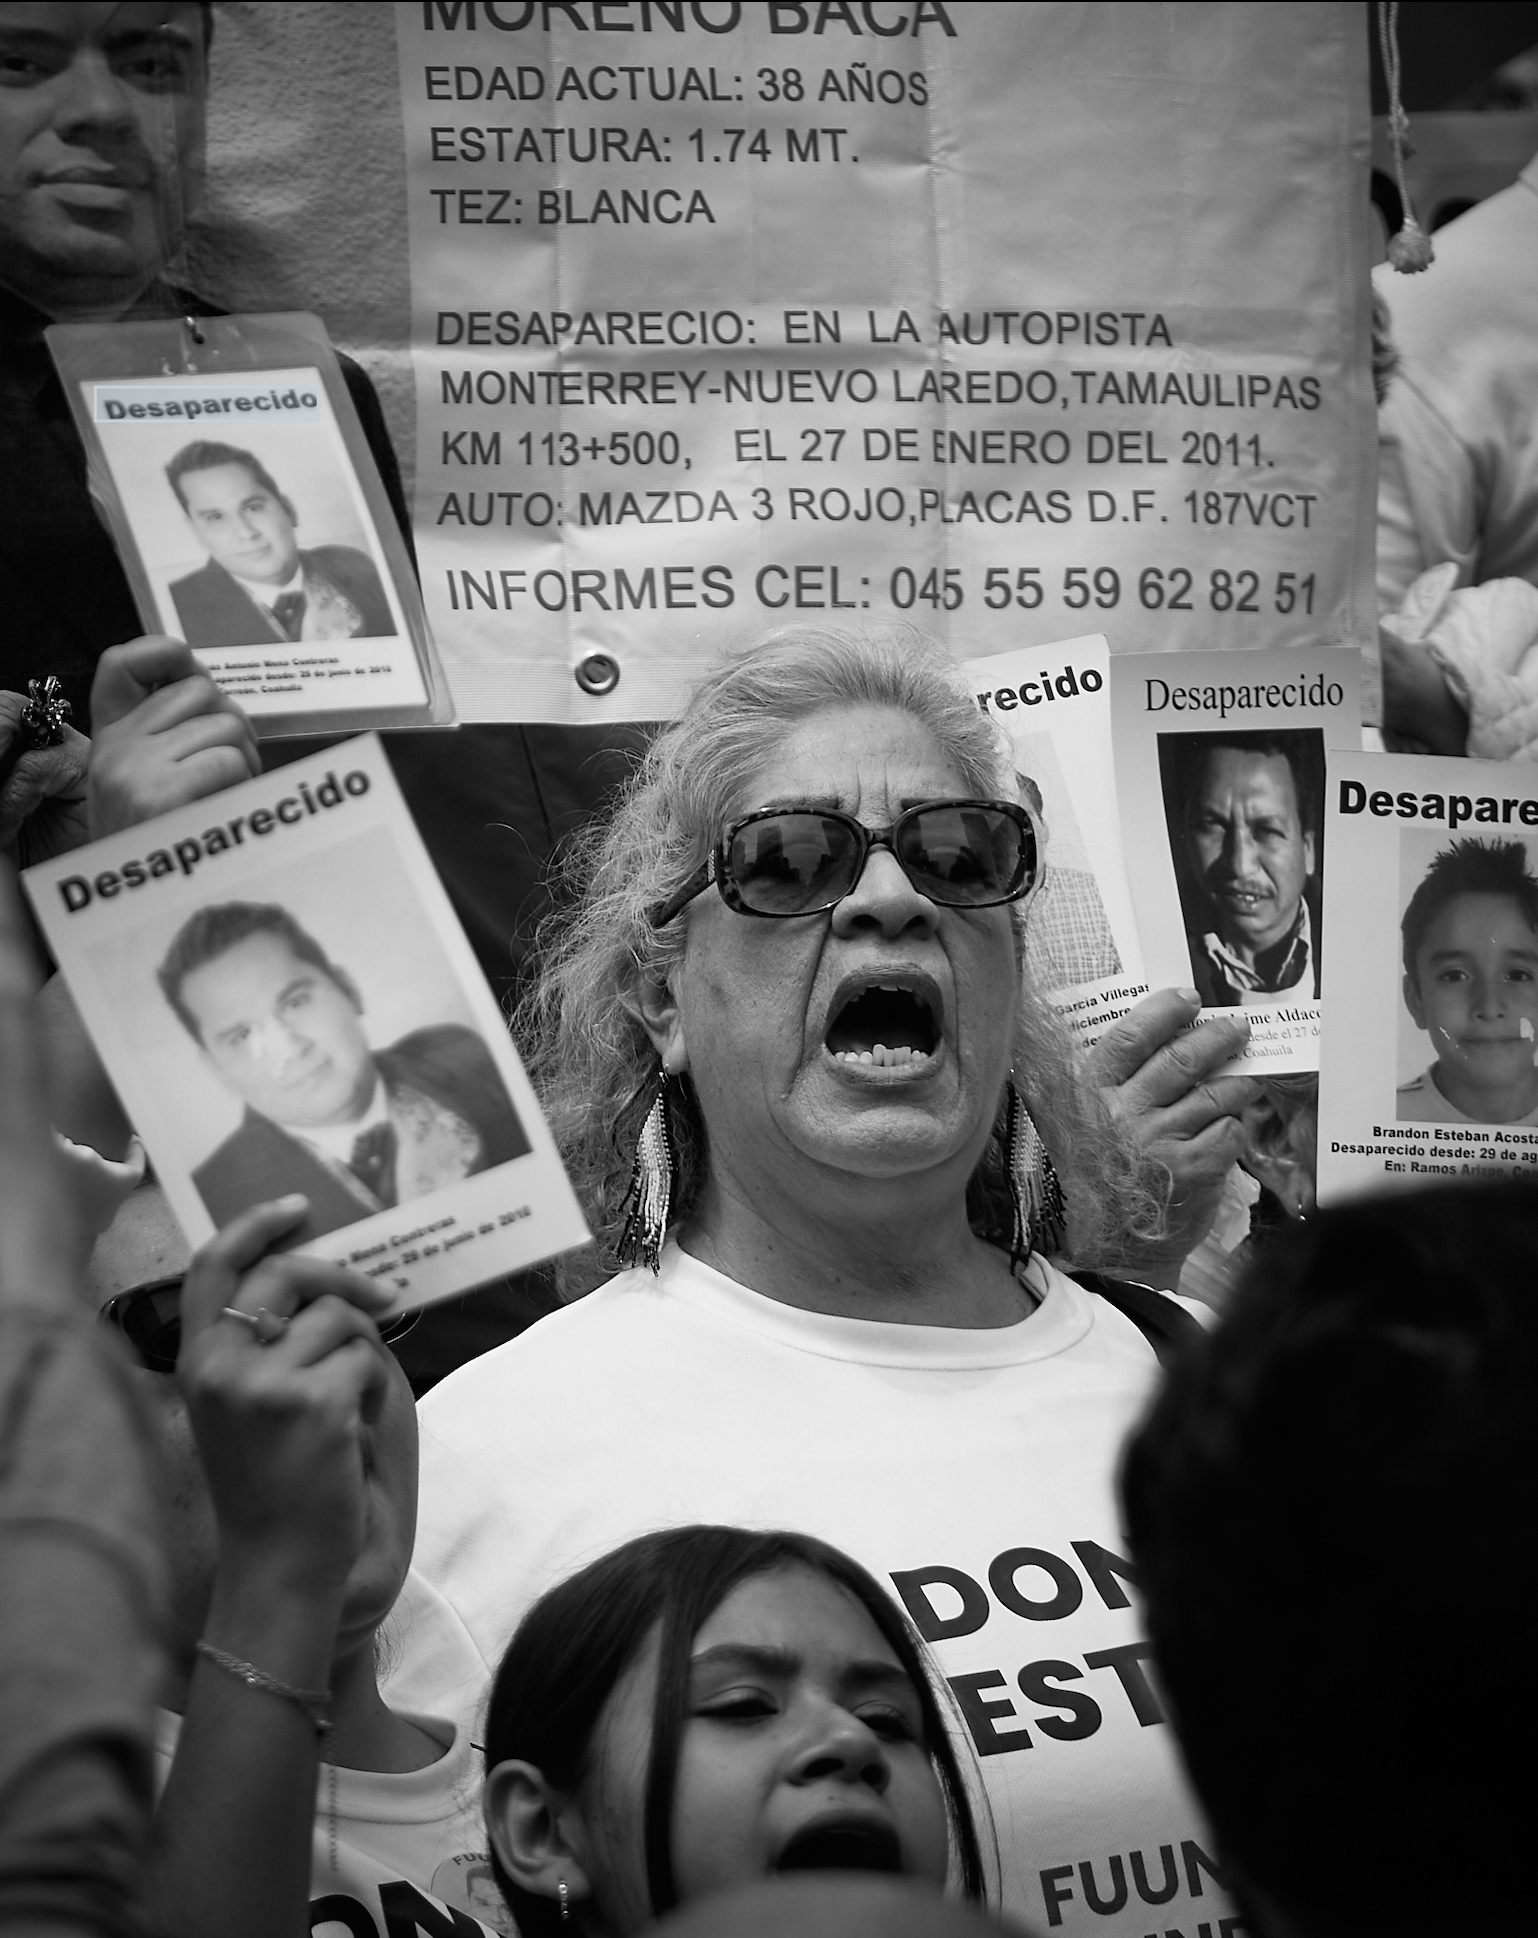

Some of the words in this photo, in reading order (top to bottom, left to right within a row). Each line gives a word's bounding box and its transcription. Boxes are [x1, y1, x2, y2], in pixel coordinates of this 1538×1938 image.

[423, 1, 743, 34] MORENO
[768, 1, 958, 37] BACA
[424, 66, 545, 101] EDAD
[556, 66, 743, 101] ACTUAL:
[757, 68, 804, 102] 38
[818, 62, 929, 106] AÑOS
[430, 127, 671, 162] ESTATURA:
[688, 128, 771, 162] 1.74
[786, 128, 859, 163] MT.
[430, 189, 522, 224] TEZ:
[537, 189, 716, 224] BLANCA
[436, 310, 756, 346] DESAPARECIO:
[784, 310, 841, 343] EN
[868, 310, 921, 343] LA
[938, 311, 1173, 347] AUTOPISTA
[104, 389, 318, 420] Desaparecido
[440, 369, 878, 405] MONTERREY-NUEVO
[441, 431, 501, 466] KM
[517, 430, 692, 470] 113+500,
[734, 428, 787, 462] EL
[800, 428, 846, 462] 27
[863, 428, 919, 462] DE
[932, 429, 1071, 464] ENERO
[1087, 430, 1168, 464] DEL
[1182, 430, 1275, 467] 2011.
[436, 492, 563, 527] AUTO:
[579, 489, 738, 526] MAZDA
[751, 487, 774, 521] 3
[1088, 490, 1168, 523] D.F.
[1185, 490, 1318, 528] 187VCT
[446, 565, 735, 612] INFORMES
[755, 564, 870, 609] CEL:
[890, 566, 964, 611] 045
[983, 567, 1044, 610] 55
[1063, 566, 1121, 610] 59
[1138, 567, 1194, 611] 62
[1209, 568, 1260, 613] 82
[1275, 572, 1317, 615] 51
[214, 673, 262, 684] aparecido
[974, 665, 1104, 715] recido
[1143, 673, 1344, 719] Desaparecido
[1339, 779, 1538, 829] Desapare
[57, 767, 372, 914] Desaparecido
[1281, 1028, 1292, 1039] el
[1295, 1026, 1307, 1038] 27
[1243, 1045, 1294, 1059] Coahuila
[1331, 1142, 1426, 1157] Desaparecido
[1429, 1146, 1476, 1159] desde:
[1479, 1147, 1496, 1160] 29
[1500, 1149, 1518, 1161] de
[1521, 1151, 1538, 1164] ag
[1372, 1126, 1430, 1140] Brandon
[1434, 1128, 1490, 1143] Esteban
[1494, 1131, 1538, 1145] Acosta
[1384, 1160, 1406, 1173] En:
[1410, 1161, 1457, 1175] Ramos
